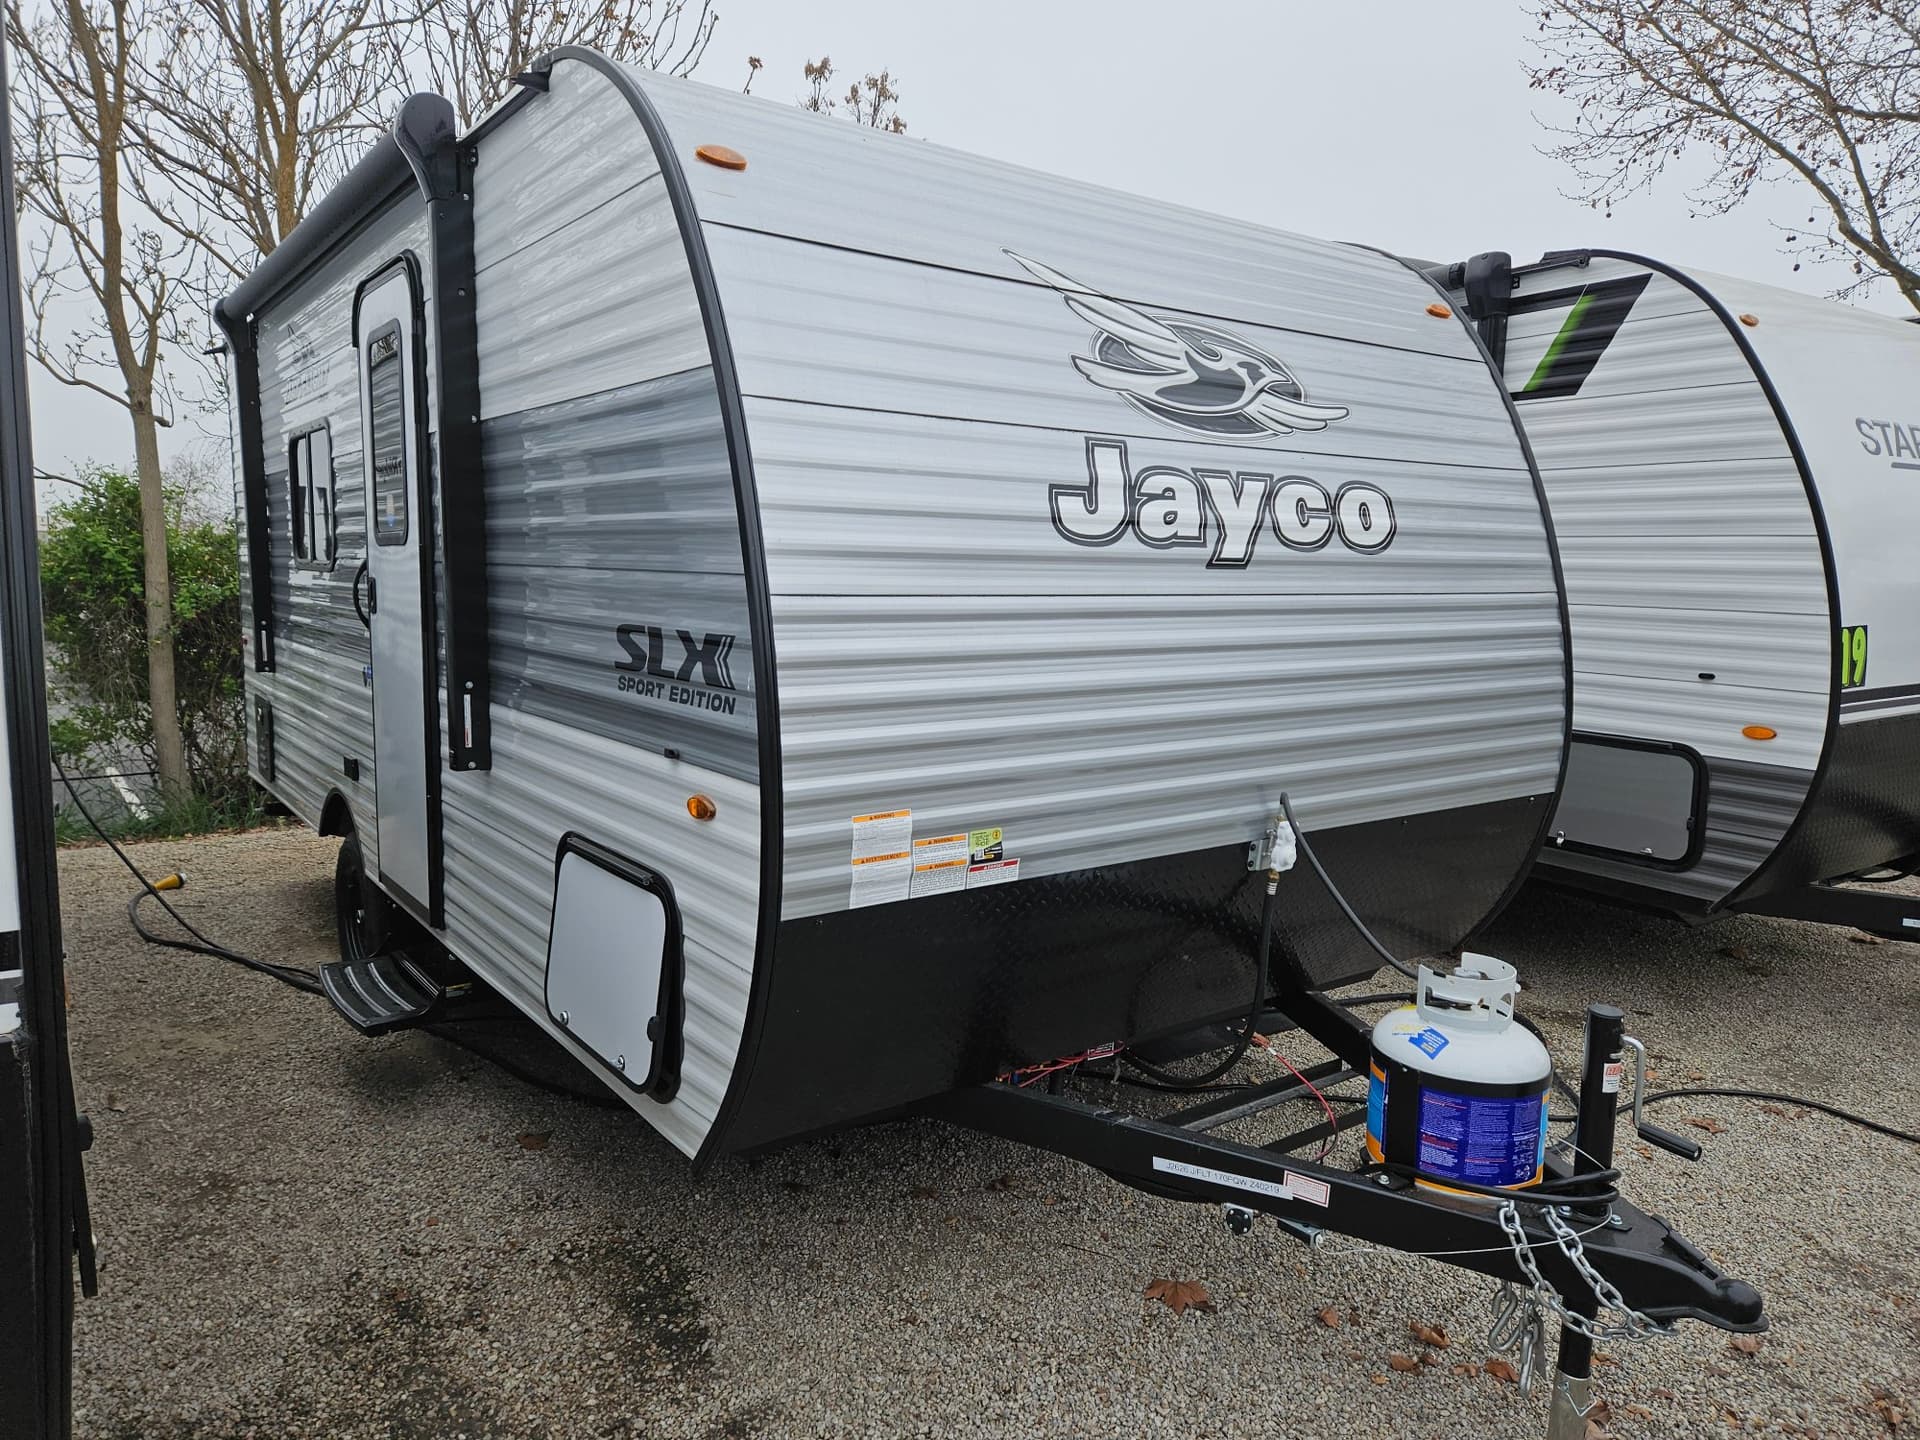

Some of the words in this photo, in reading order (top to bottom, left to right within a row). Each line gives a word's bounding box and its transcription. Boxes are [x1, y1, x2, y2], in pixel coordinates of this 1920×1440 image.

[1049, 436, 1397, 569] Jayco
[614, 623, 736, 690] SLX
[1842, 626, 1867, 687] 19
[617, 675, 665, 699] SPORT
[668, 684, 736, 715] EDITION
